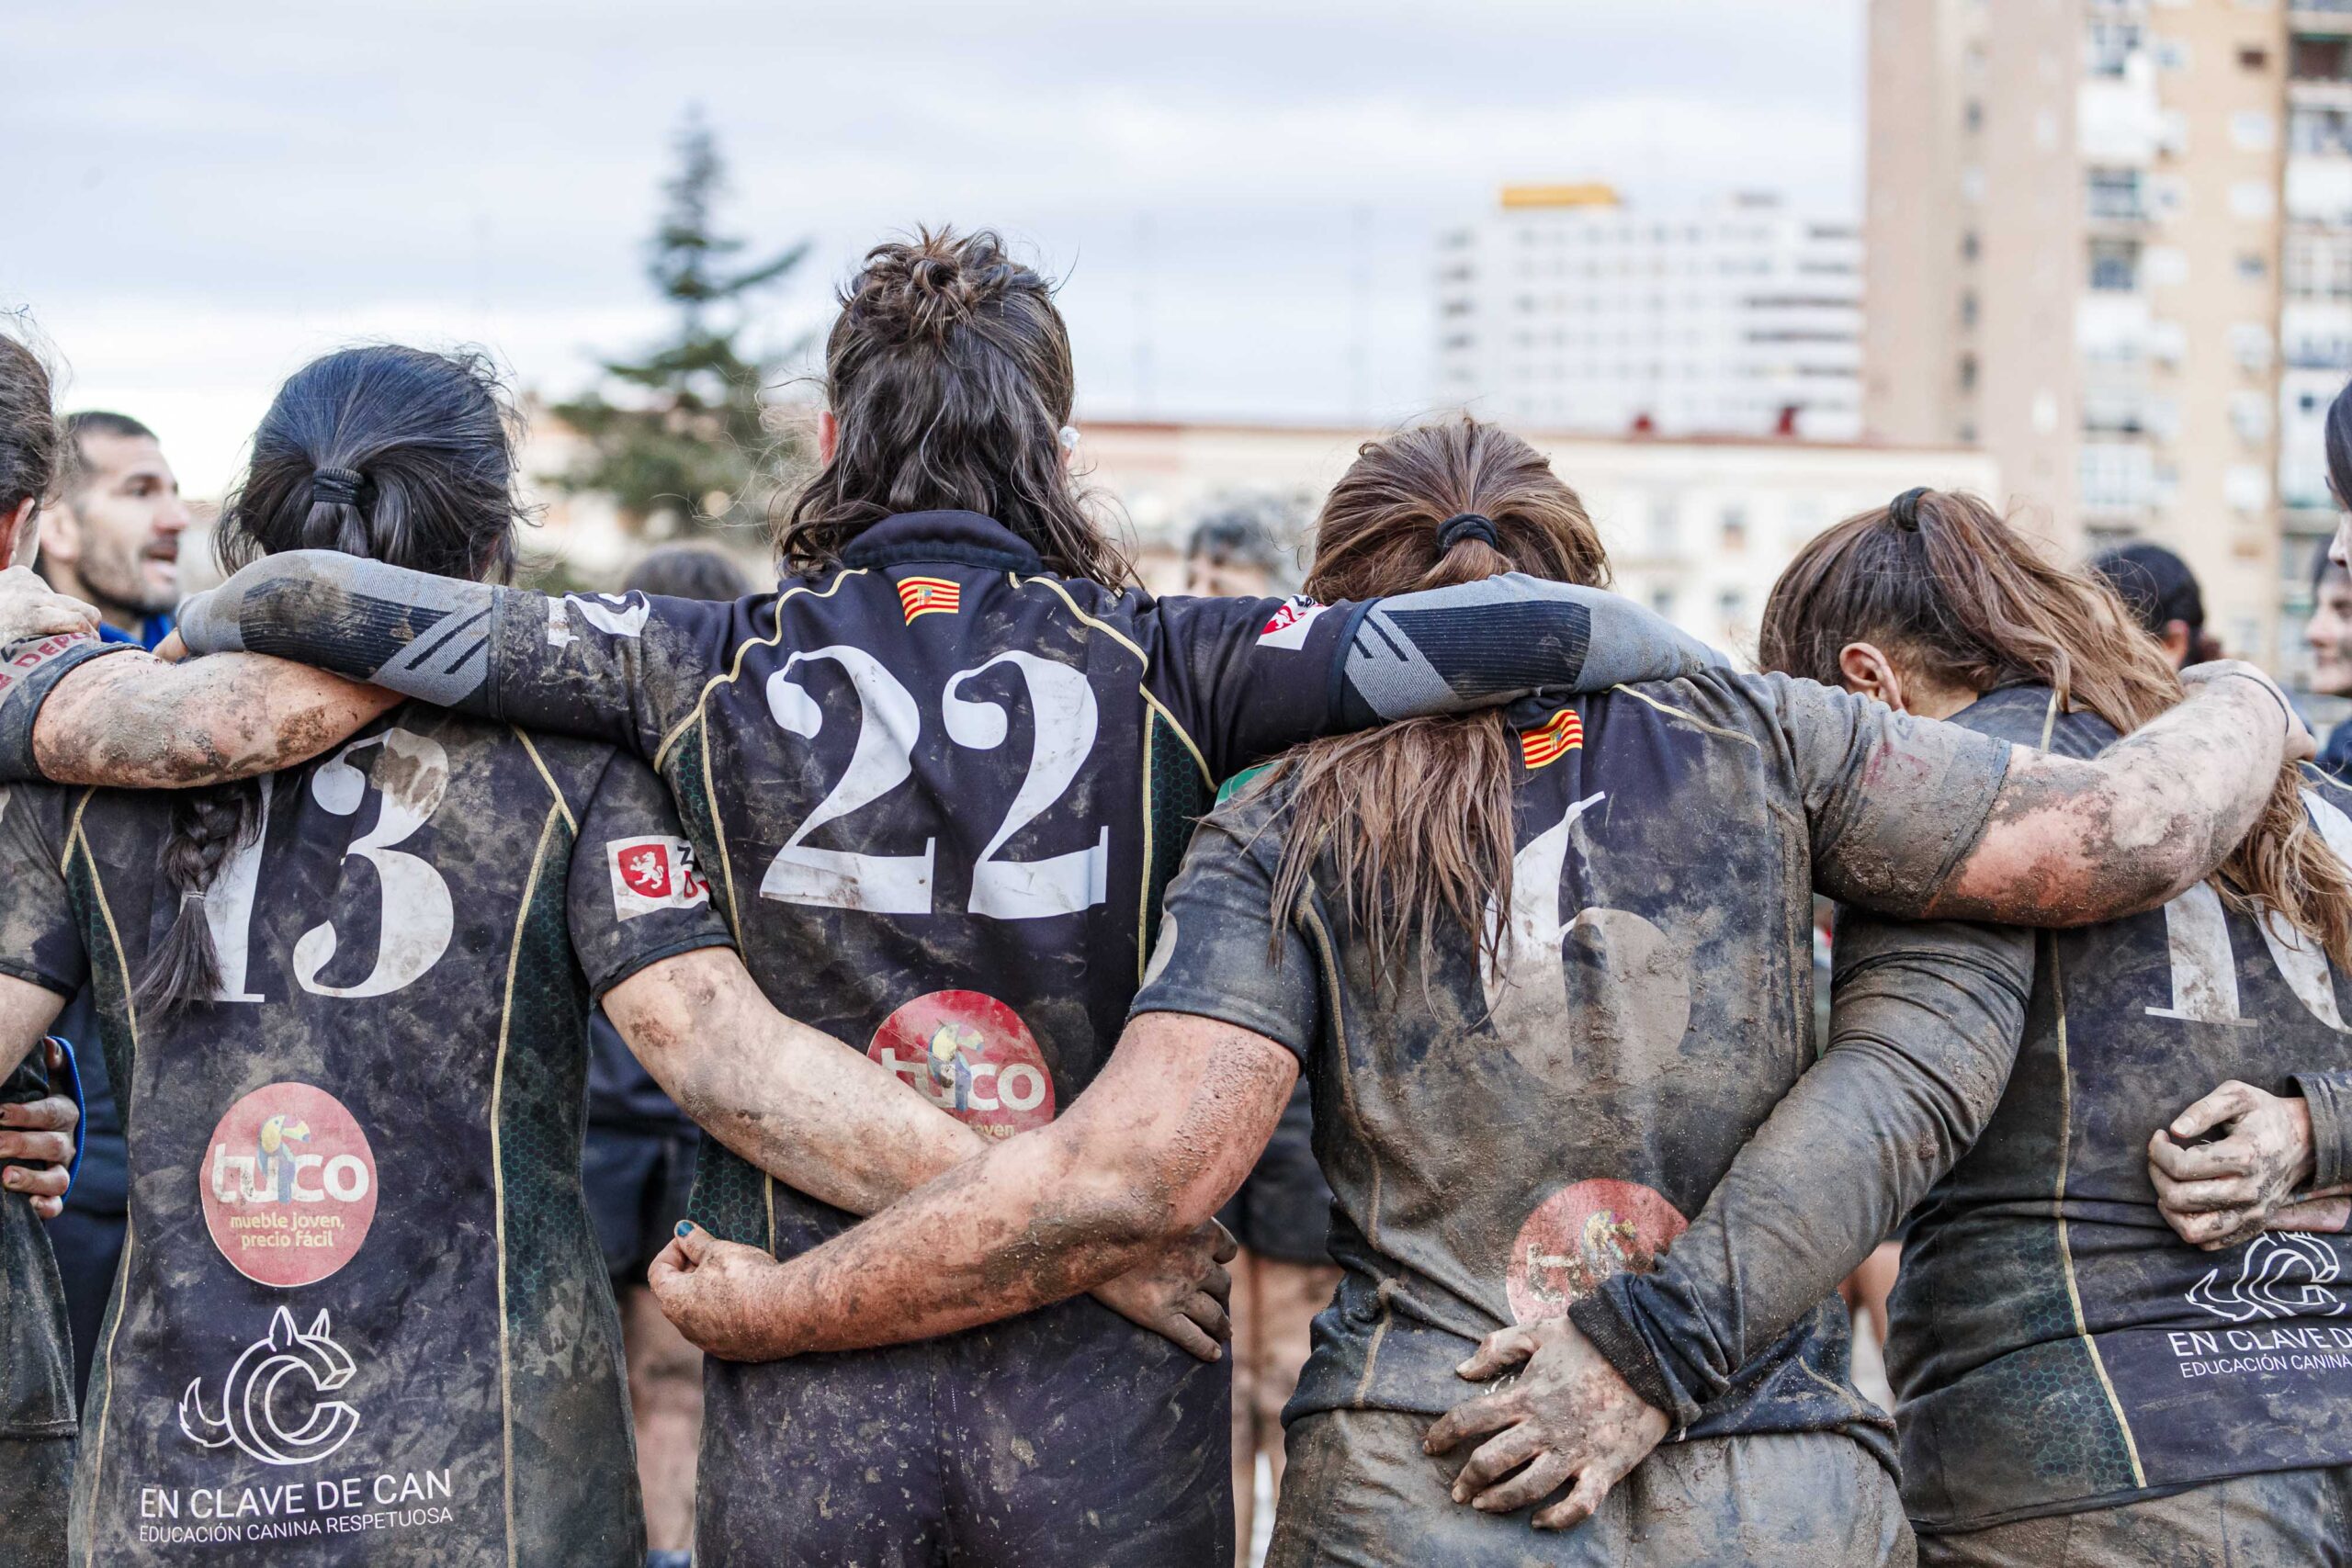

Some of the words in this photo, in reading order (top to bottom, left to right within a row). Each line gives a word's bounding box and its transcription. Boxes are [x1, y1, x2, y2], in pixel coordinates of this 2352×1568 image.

[760, 645, 1109, 919] 22
[212, 1143, 369, 1202] tuco
[231, 1212, 288, 1229] mueble
[291, 1212, 345, 1232] joven,
[241, 1233, 291, 1250] precio
[295, 1230, 334, 1247] fácil
[2167, 1331, 2220, 1357] EN
[2226, 1327, 2333, 1352] CLAVE
[2179, 1353, 2288, 1379] EDUCACIÓN
[2290, 1353, 2352, 1371] CANINA
[140, 1487, 180, 1519] EN
[190, 1483, 307, 1519] CLAVE
[316, 1477, 364, 1511] DE
[373, 1468, 453, 1505] CAN
[140, 1522, 243, 1543] EDUCACIÓN
[246, 1519, 322, 1541] CANINA
[326, 1506, 455, 1534] RESPETUOSA
